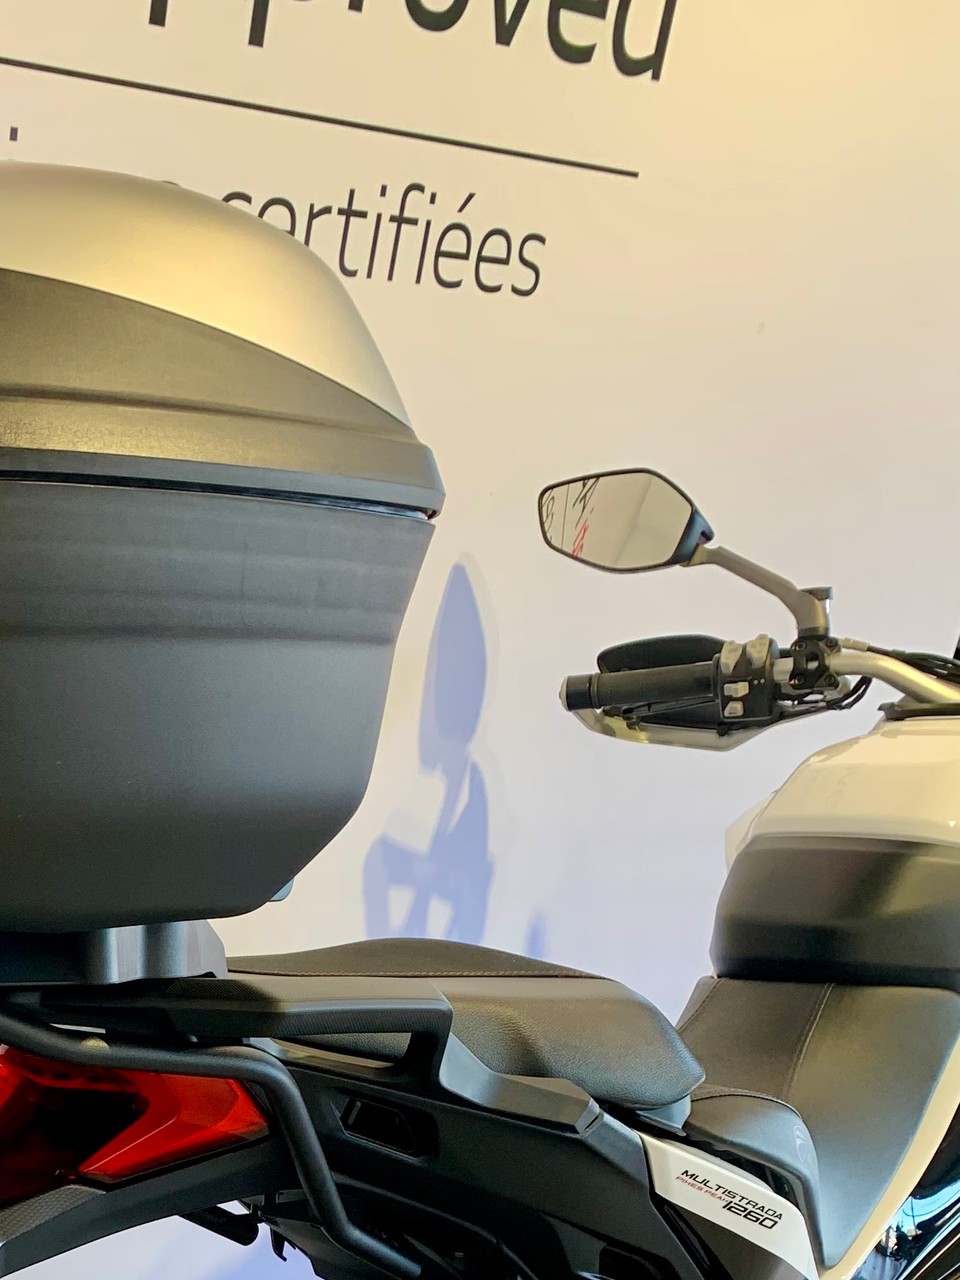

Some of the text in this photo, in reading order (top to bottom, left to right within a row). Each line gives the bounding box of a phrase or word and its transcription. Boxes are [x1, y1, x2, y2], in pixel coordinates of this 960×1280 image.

[221, 182, 548, 297] rtifiées
[681, 1170, 783, 1219] MULTISTRADA
[722, 1200, 778, 1229] 1260
